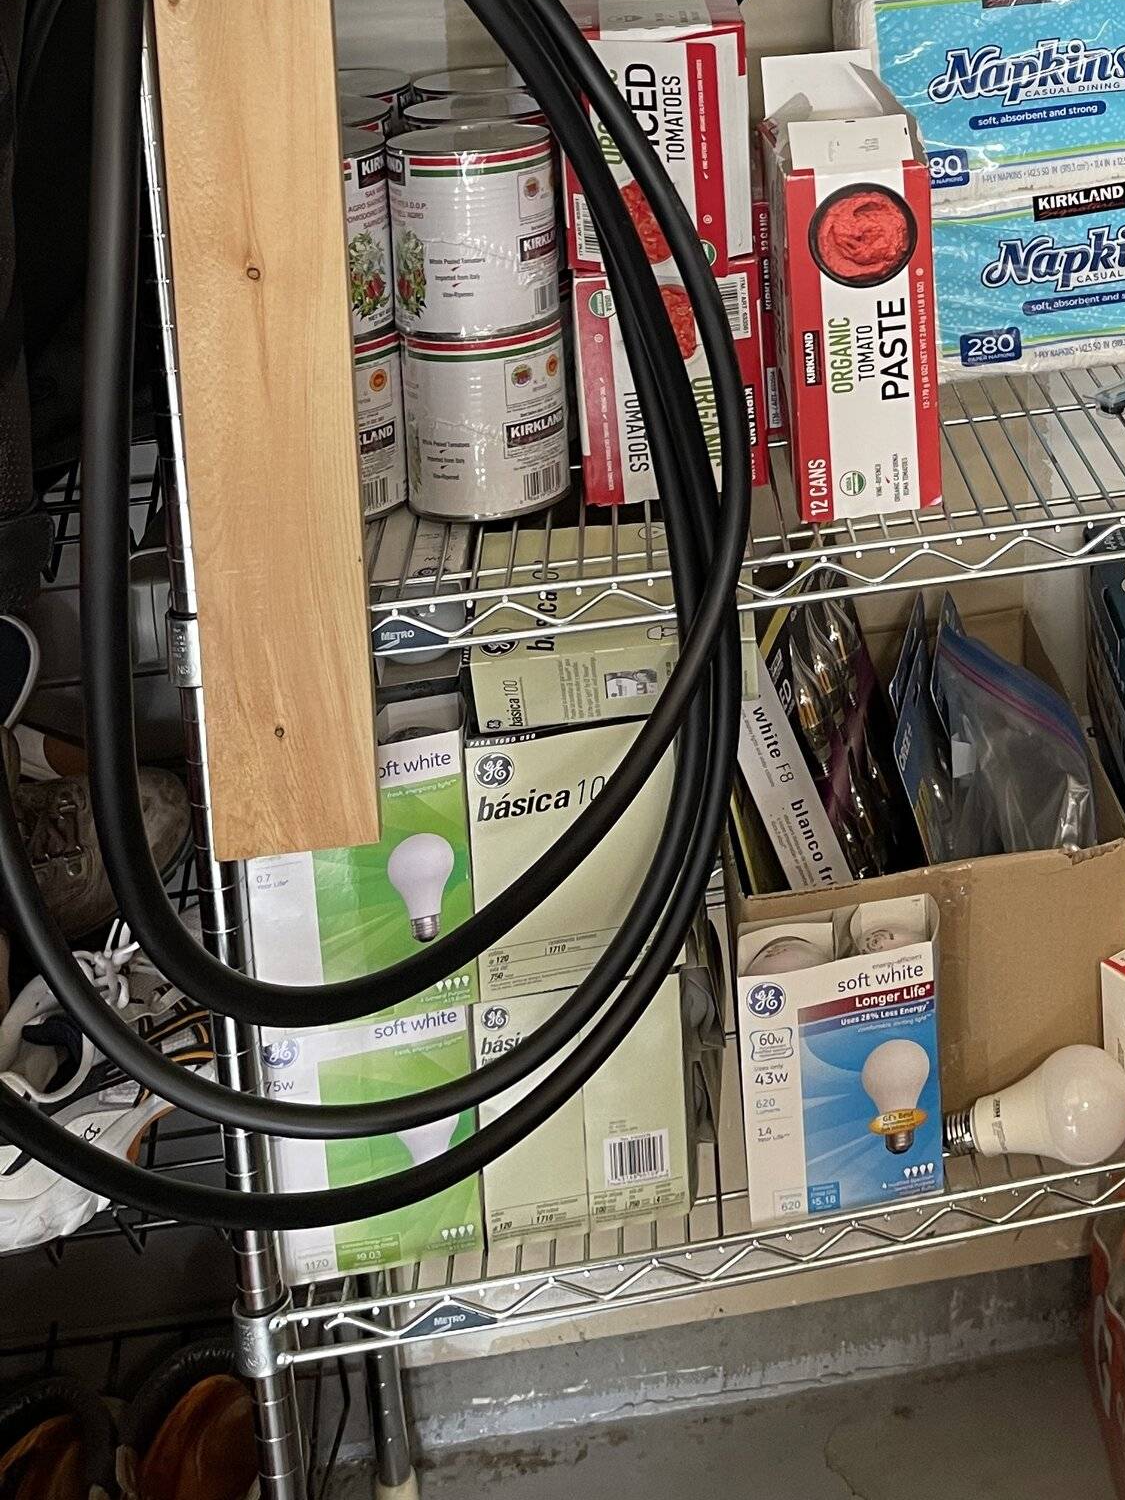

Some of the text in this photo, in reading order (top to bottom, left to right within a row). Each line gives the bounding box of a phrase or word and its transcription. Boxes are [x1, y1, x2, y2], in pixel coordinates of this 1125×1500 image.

[1025, 82, 1121, 98] CASUAL DINING
[624, 63, 660, 146] CED
[977, 104, 1098, 128] soft, absorbent and strong
[662, 75, 686, 163] TOMATOES
[930, 153, 962, 176] 80
[1038, 186, 1124, 210] KIRKLAND
[1076, 271, 1123, 283] CASUAL
[1030, 300, 1052, 312] soft,
[1053, 295, 1100, 308] absorbent
[1101, 292, 1119, 303] and
[828, 317, 853, 395] ORGANIC
[855, 325, 876, 382] TOMATO
[876, 297, 910, 401] PASTE
[968, 333, 1015, 356] 280
[804, 332, 816, 385] KIRKLAND
[808, 459, 829, 517] 12 CANS
[381, 630, 414, 641] METRO
[508, 679, 524, 728] básica 100
[752, 706, 795, 783] white F8
[403, 752, 451, 773] white
[476, 776, 607, 823] básica 10
[790, 798, 823, 862] blanco
[549, 944, 567, 953] 1710
[838, 962, 924, 992] soft white
[855, 990, 900, 1008] Longer
[374, 1010, 457, 1039] soft white
[840, 1009, 899, 1026] Uses 28% Less
[481, 1034, 525, 1057] bási
[756, 1098, 776, 1109] 620
[781, 1201, 801, 1212] 620
[304, 1257, 330, 1271] 1170
[433, 1313, 466, 1326] METRO
